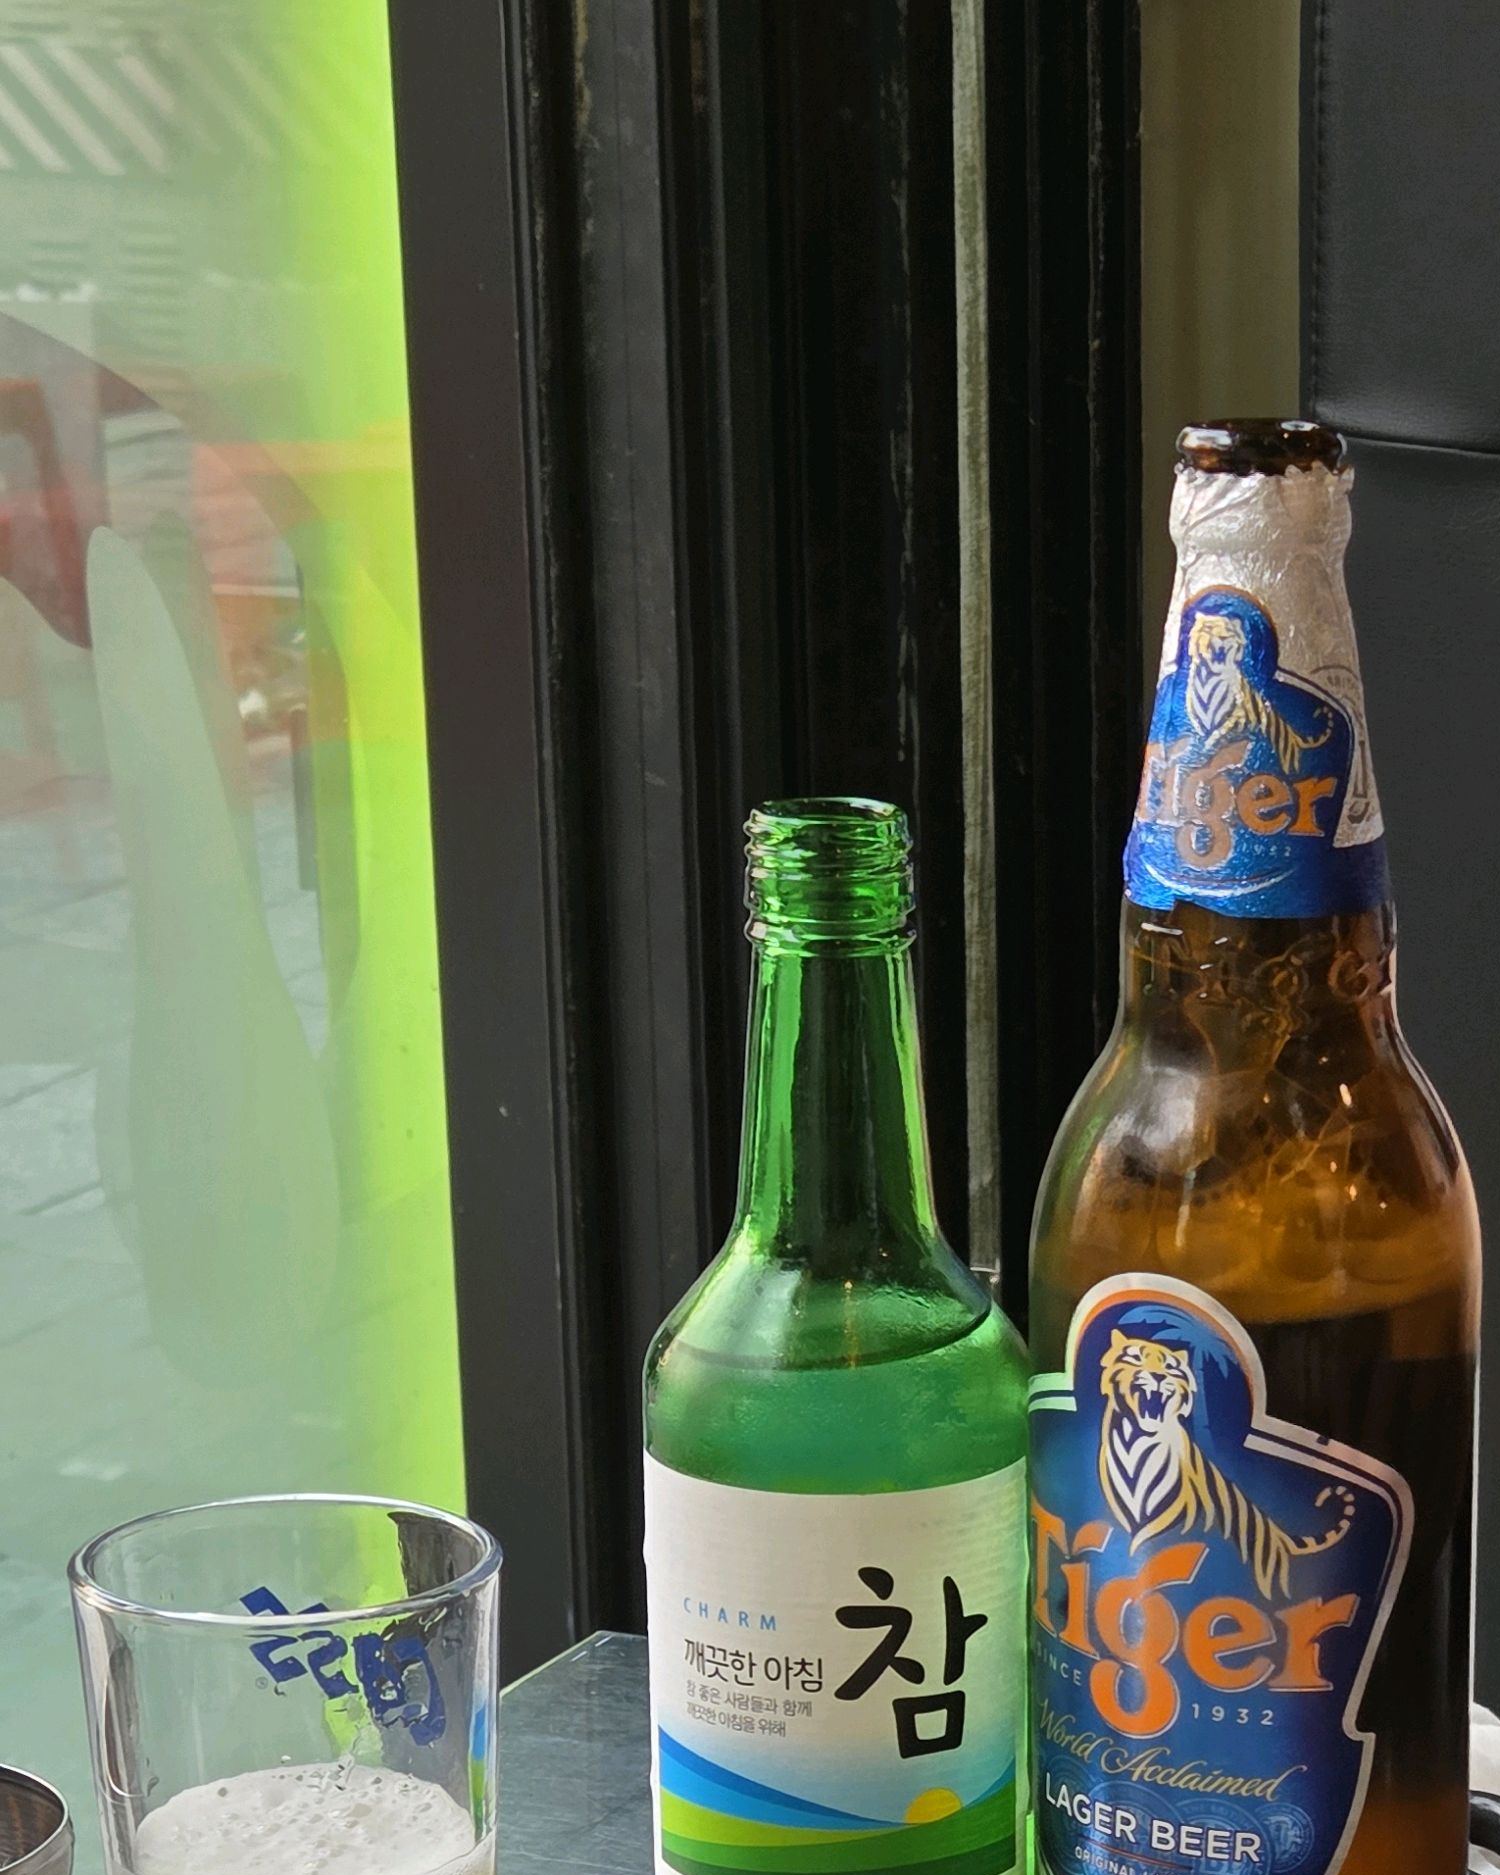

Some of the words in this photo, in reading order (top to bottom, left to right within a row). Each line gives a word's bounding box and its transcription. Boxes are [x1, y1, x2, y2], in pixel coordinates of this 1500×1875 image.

[1135, 735, 1338, 869] Tiger
[684, 1596, 777, 1632] CHARM
[1032, 1496, 1360, 1737] Tiger
[684, 1638, 757, 1687] 깨끗한
[764, 1656, 824, 1693] 아침
[699, 1684, 721, 1705] 좋은
[725, 1690, 779, 1714] 사람들과
[783, 1699, 813, 1718] 함께
[834, 1566, 988, 1759] 참
[1035, 1642, 1082, 1686] SINCE
[1190, 1703, 1275, 1726] 1932
[686, 1702, 718, 1726] 깨끗한
[718, 1712, 756, 1735] 아침을
[758, 1720, 787, 1737] 위해
[1039, 1698, 1114, 1759] World
[1101, 1739, 1308, 1802] Acclaimed
[1045, 1771, 1138, 1844] LAGER
[1150, 1818, 1262, 1864] BEER
